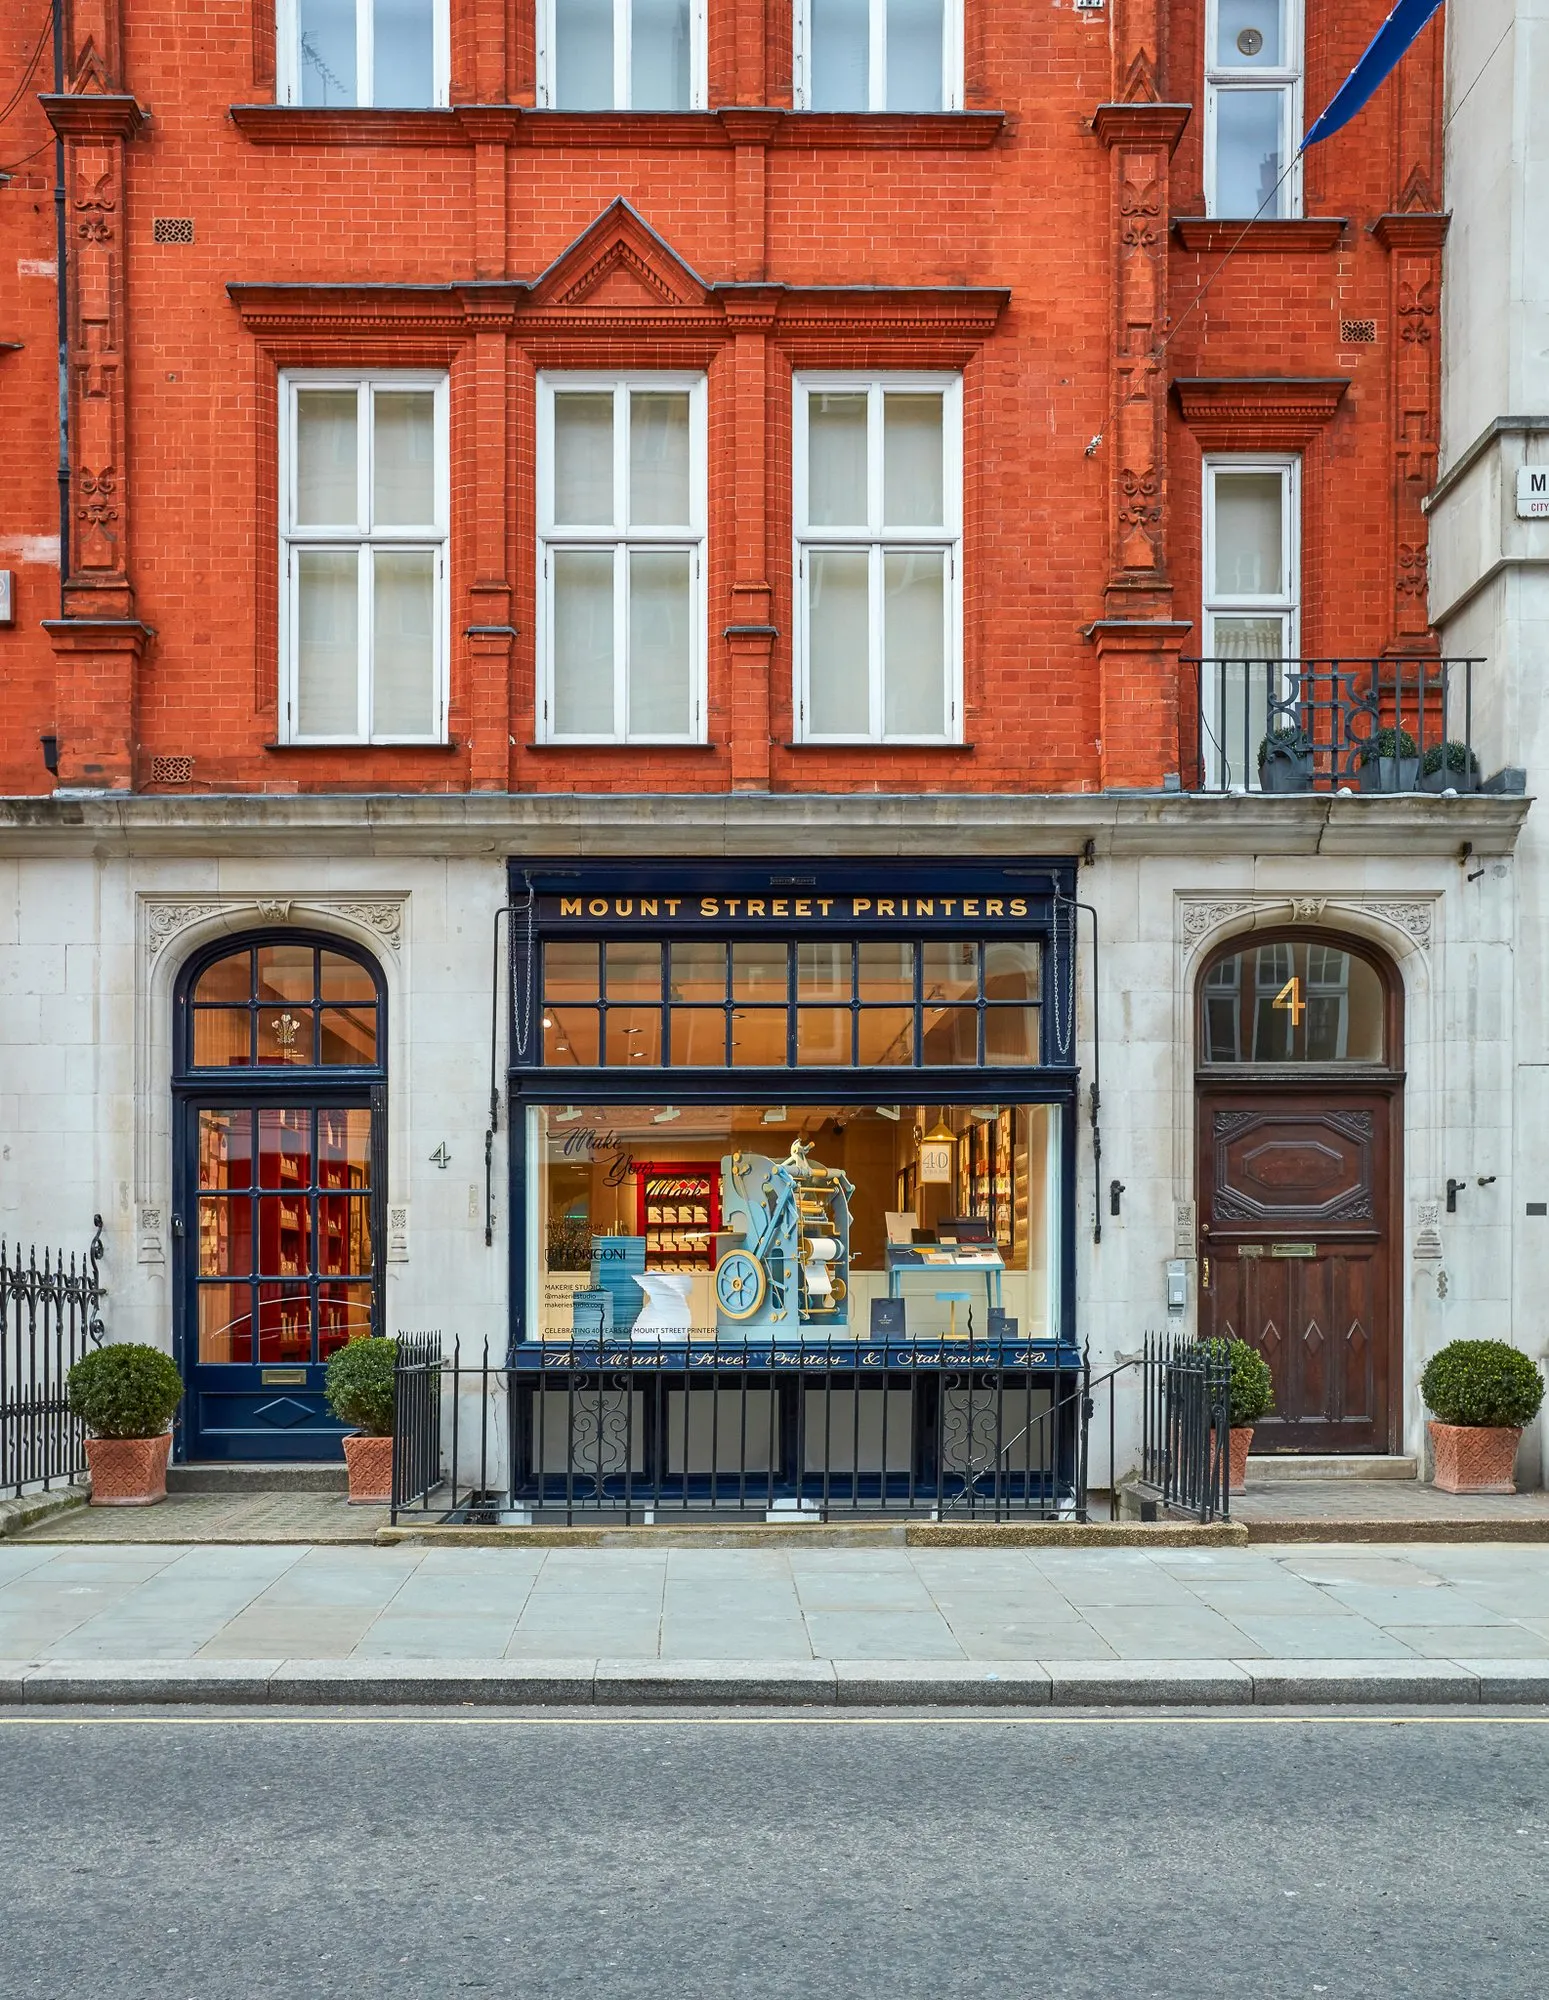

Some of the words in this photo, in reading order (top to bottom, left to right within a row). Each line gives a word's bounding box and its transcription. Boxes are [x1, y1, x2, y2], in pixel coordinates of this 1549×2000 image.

[1531, 503, 1549, 512] CITY
[560, 898, 682, 916] MOUNT
[700, 898, 834, 916] STREET
[853, 898, 1028, 916] PRINTERS
[1272, 977, 1306, 1026] 4
[546, 1127, 622, 1156] Make
[429, 1141, 451, 1169] 4
[923, 1151, 948, 1169] 40
[591, 1152, 655, 1187] Your
[643, 1179, 704, 1203] Mark
[544, 1352, 580, 1366] The
[862, 1352, 880, 1365] &
